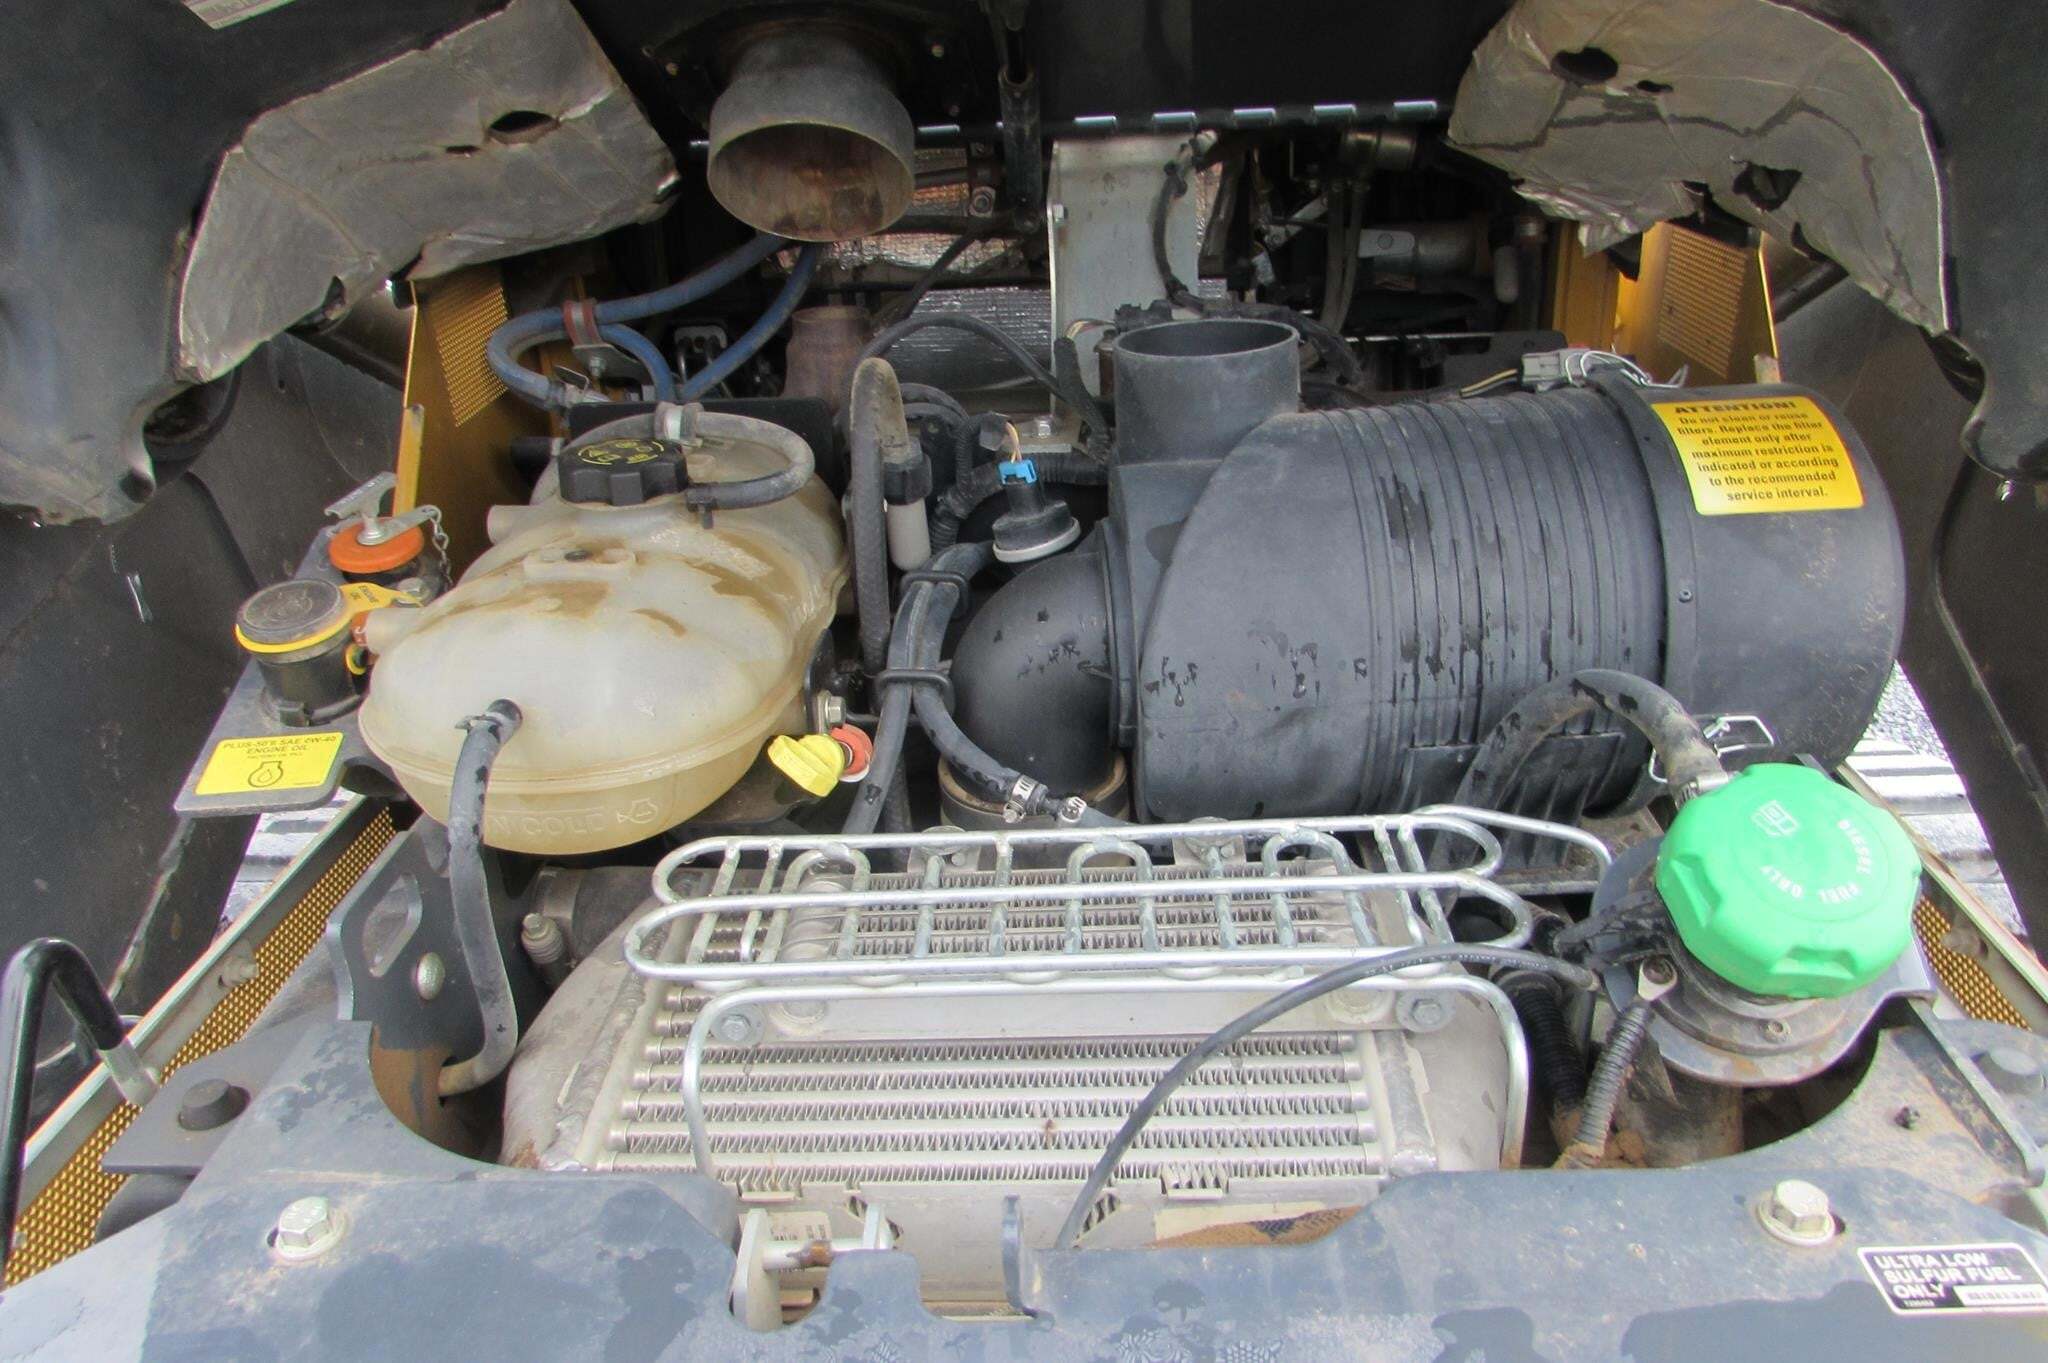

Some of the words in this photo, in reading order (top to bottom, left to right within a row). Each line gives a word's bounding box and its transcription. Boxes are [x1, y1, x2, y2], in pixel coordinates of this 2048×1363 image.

[1675, 401, 1796, 414] ATTENTION!
[1702, 436, 1751, 445] element
[1754, 434, 1780, 444] only
[1784, 433, 1811, 441] after
[1692, 449, 1752, 459] maximum
[1755, 445, 1819, 456] restriction
[1822, 444, 1833, 453] is
[1698, 460, 1756, 472] indicated
[1759, 462, 1773, 470] or
[1776, 457, 1839, 469] according
[1709, 477, 1722, 486] to
[1725, 474, 1744, 486] the
[1748, 470, 1836, 484] recommended
[1727, 491, 1773, 501] service
[1873, 1253, 1941, 1269] ULTRA
[1941, 1252, 1989, 1267] LOW
[1883, 1267, 1967, 1284] SULFUR
[1966, 1266, 2022, 1281] FUEL
[1893, 1283, 1946, 1299] ONLY
